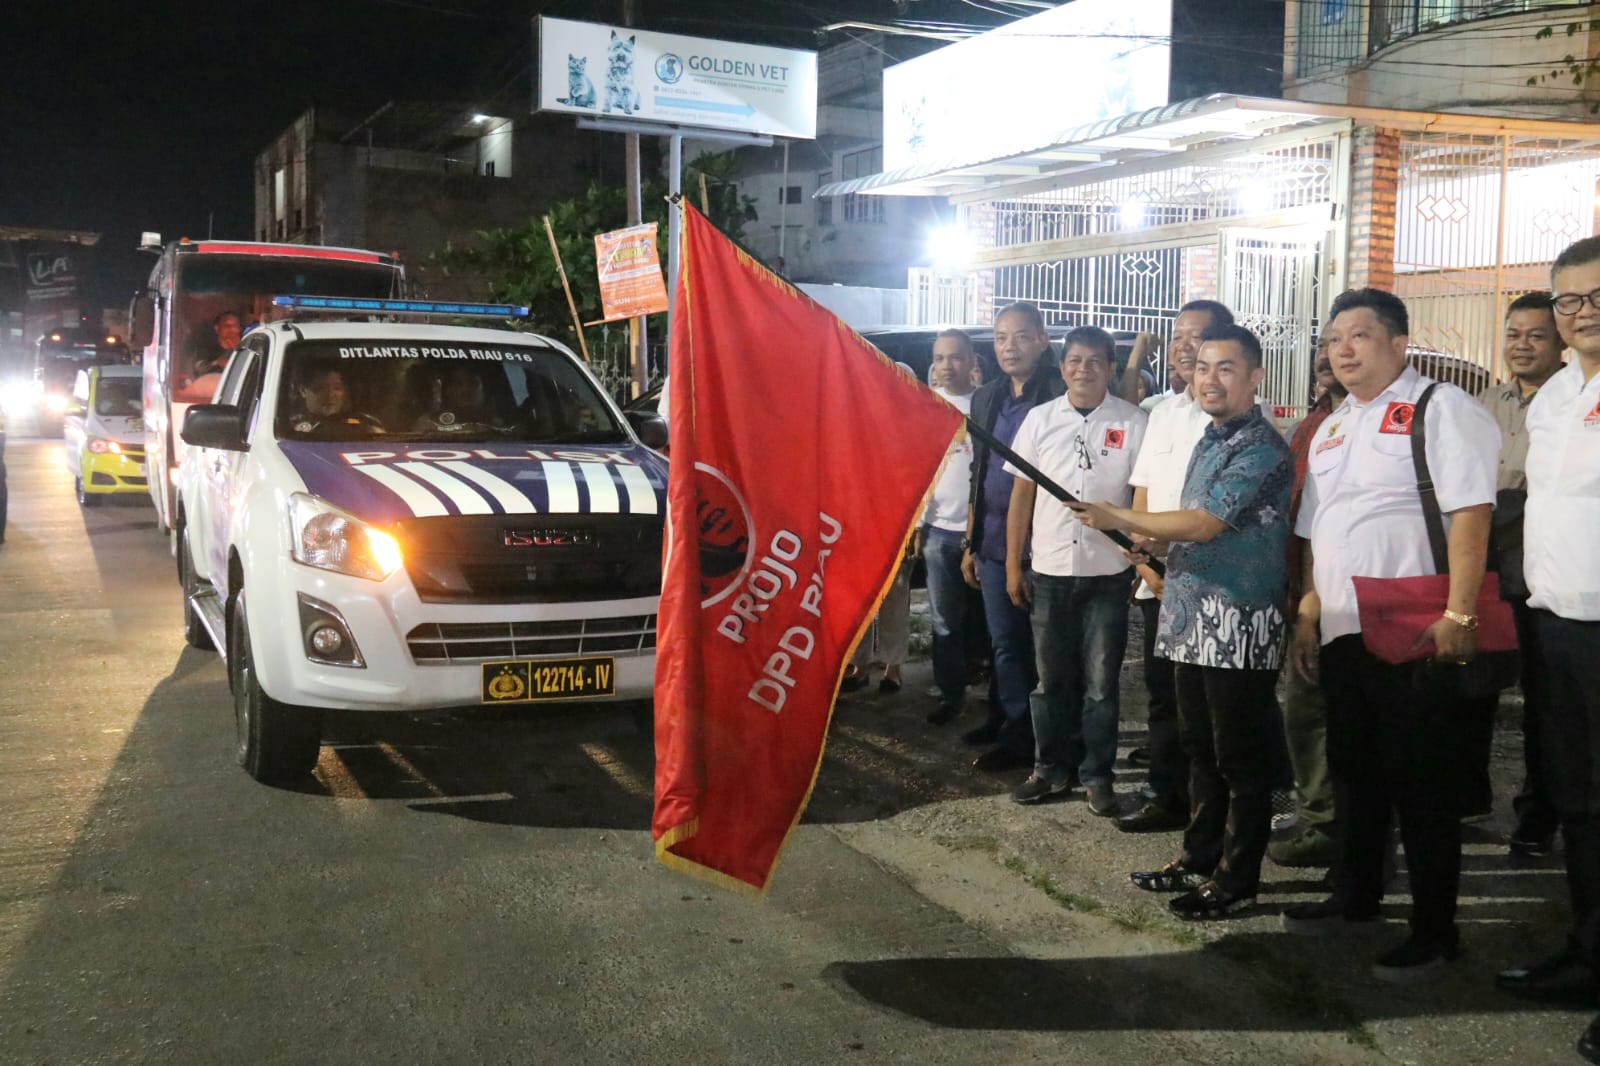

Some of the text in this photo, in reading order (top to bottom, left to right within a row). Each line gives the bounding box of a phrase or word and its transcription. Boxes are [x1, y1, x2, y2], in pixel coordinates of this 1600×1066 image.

[688, 55, 789, 80] GOLDEN VET
[339, 347, 532, 362] DITLANTAS POLDA RIAU 616
[340, 450, 635, 465] POLISI
[504, 529, 592, 545] ISUZU
[717, 529, 801, 643] PROJO
[748, 625, 815, 714] DPD
